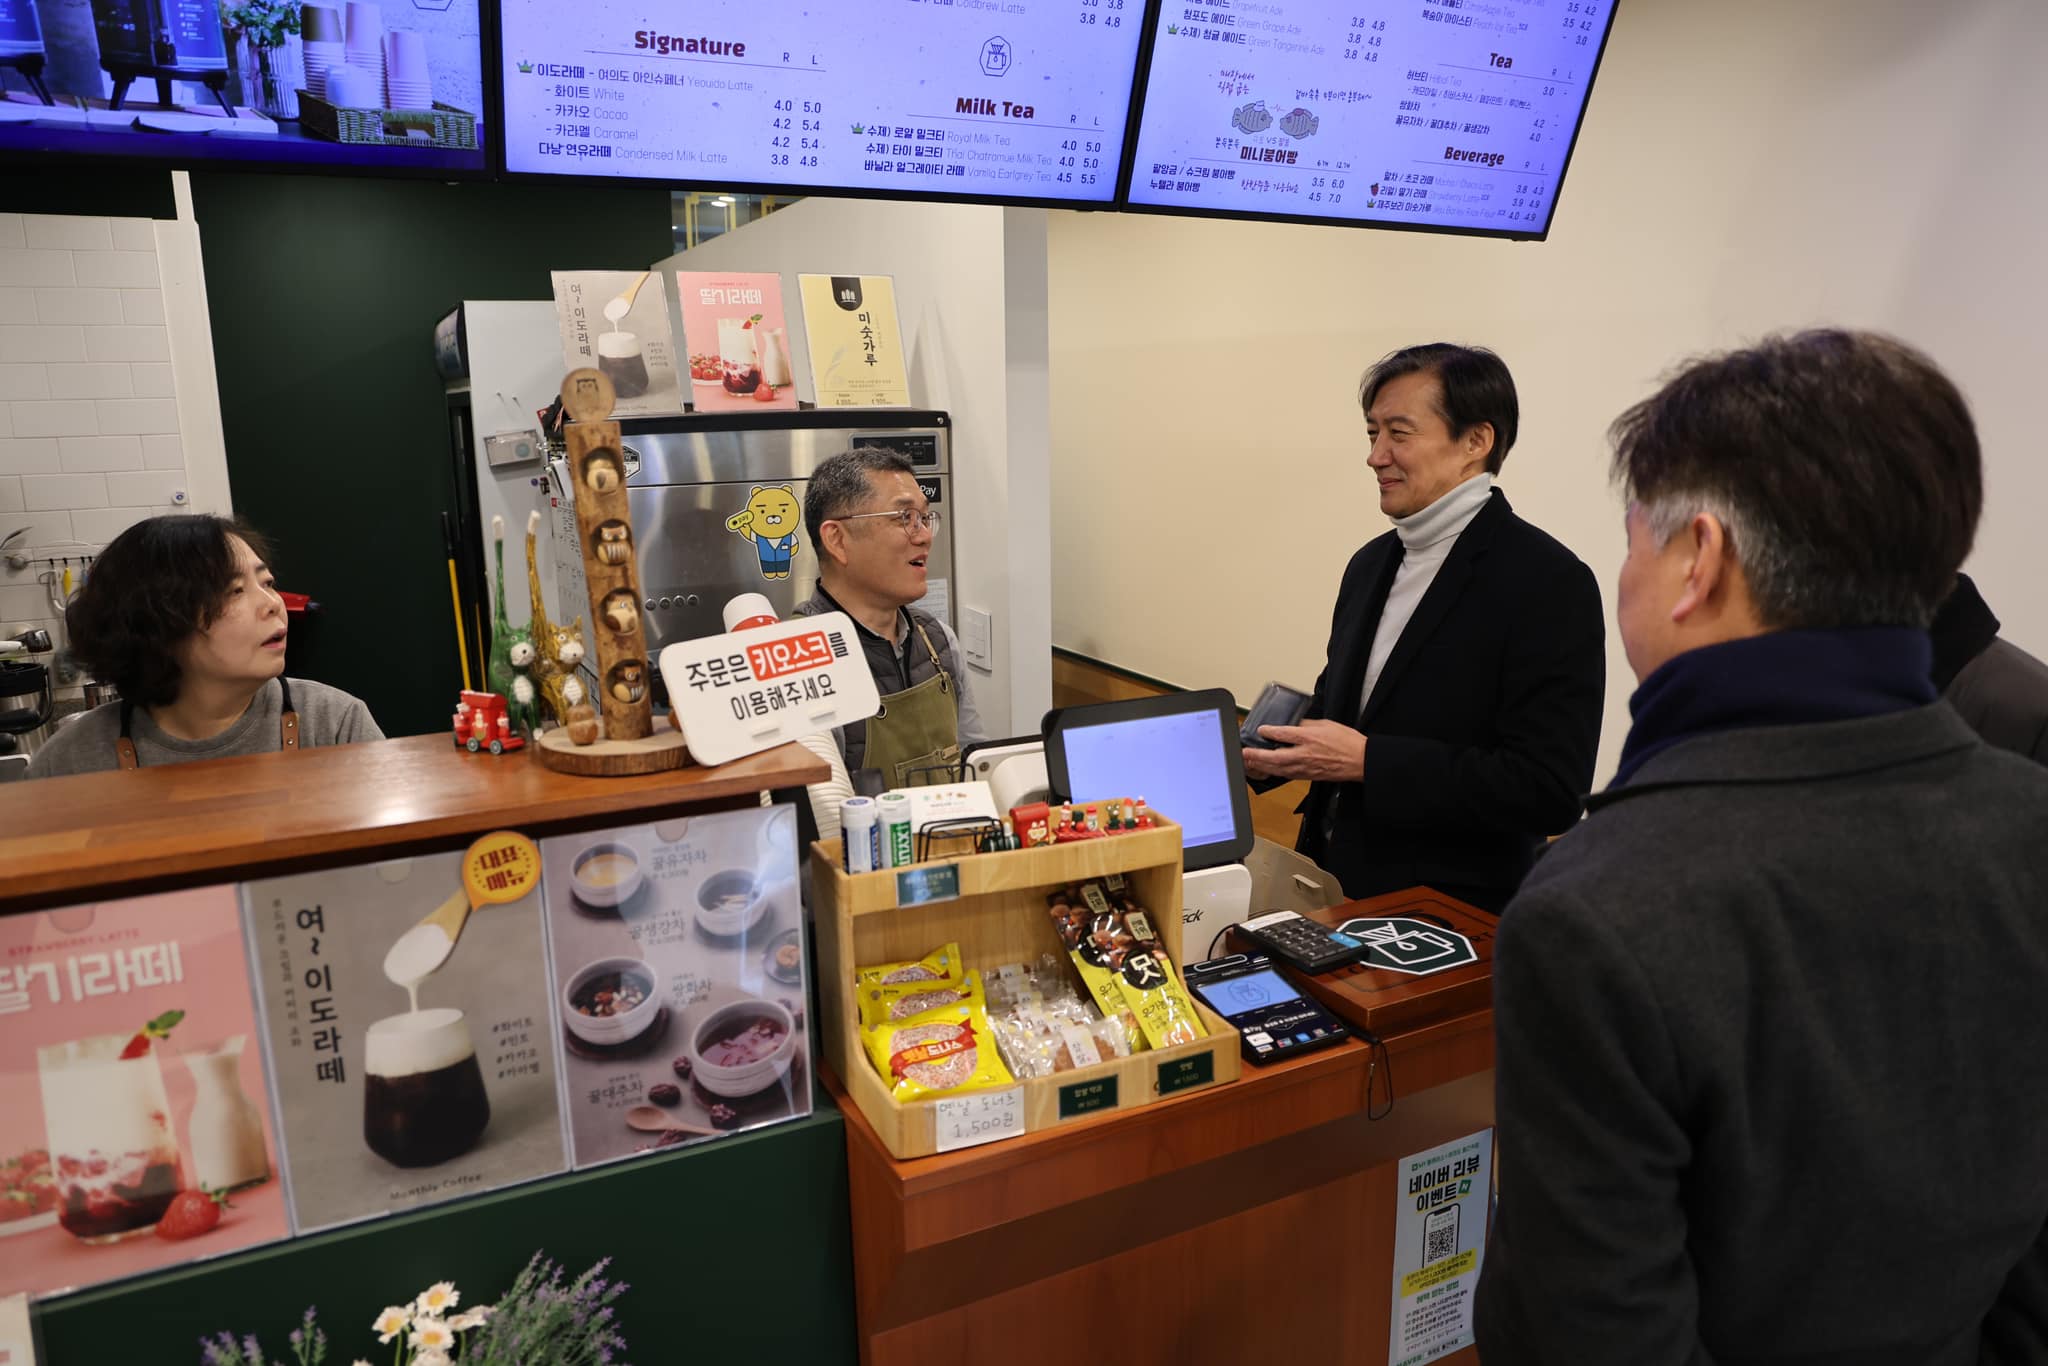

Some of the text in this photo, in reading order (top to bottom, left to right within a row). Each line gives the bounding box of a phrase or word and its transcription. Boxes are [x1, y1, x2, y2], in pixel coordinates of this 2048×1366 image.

[1001, 4, 1025, 15] Latte
[1567, 2, 1597, 16] 3.5 4.2
[1080, 13, 1120, 28] 3.8 4.8
[1211, 12, 1236, 26] 에이드
[1351, 17, 1386, 31] 3.8 4.8
[1562, 18, 1592, 31] 3.5 4.2
[1180, 26, 1201, 38] 수제)
[1221, 31, 1247, 45] 에이드
[1422, 9, 1444, 22] 복숭아
[1444, 12, 1473, 27] 아이스티
[1576, 35, 1588, 46] 3.0
[634, 30, 746, 57] Signature
[1347, 33, 1382, 47] 3.8 4.8
[783, 52, 818, 65] R L
[1344, 49, 1378, 63] 3.8 4.8
[1489, 52, 1513, 69] Tea
[537, 63, 753, 92] 이도라떼 여의도 아인슈페너 Yeouido Latte
[1406, 69, 1428, 82] 허브티
[1542, 86, 1555, 97] 3.0
[554, 84, 624, 101] 화이트 White
[554, 105, 629, 121] 카카오 Cacao
[774, 100, 821, 114] 4.0 5.0
[956, 97, 1035, 119] Milk Tea
[773, 118, 820, 132] 4.2 5.4
[1070, 115, 1099, 126] R L
[1533, 119, 1545, 129] 4.2
[554, 124, 638, 140] 카라멜 Caramel
[867, 126, 1010, 146] 수제) 로얄 밀크티 Royal Milk Tea
[1266, 136, 1277, 144] VS
[1529, 132, 1541, 143] 4.0
[772, 136, 819, 150] 4.2 5.4
[1062, 140, 1101, 153] 4.0 5.0
[539, 142, 728, 165] 다낭 연유라떼 Condensed Milk Latte
[771, 154, 818, 167] 3.8 4.8
[866, 143, 889, 155] 수제)
[892, 144, 912, 157] 타이
[914, 146, 943, 158] 밀크티
[946, 147, 965, 159] Thai
[1016, 153, 1034, 165] Milk
[1036, 154, 1052, 166] Tea
[1240, 146, 1299, 164] 미니붕어빵
[1444, 146, 1505, 167] Beverage
[1059, 156, 1098, 169] 4.0 5.0
[864, 160, 894, 172] 바닐라
[896, 161, 943, 176] 얼그레이티
[946, 165, 965, 176] 라떼
[1034, 170, 1051, 183] Tea
[1057, 172, 1096, 184] 4.5 5.5
[1152, 163, 1236, 180] 팥앙금 슈크림 붕어빵
[1404, 173, 1419, 184] 초코
[1419, 174, 1434, 185] 라떼
[1150, 179, 1201, 192] 누텔라 붕어빵
[1311, 177, 1345, 189] 3.5 6.0
[1308, 191, 1341, 204] 4.5 7.0
[1399, 187, 1412, 198] 딸기
[1413, 188, 1428, 199] 라떼
[1404, 202, 1432, 213] 미숫가루
[700, 288, 762, 305] 딸기라떼
[858, 311, 878, 367] 미숫가루
[686, 631, 849, 692] 주문은 키오스크를
[730, 673, 837, 721] 이용해주세요
[480, 845, 521, 870] 대표
[485, 869, 525, 892] 메뉴
[296, 904, 346, 1083] 여~이도라떼
[954, 1112, 1014, 1138] 1,500원
[1409, 1165, 1450, 1194] 네이버
[1453, 1154, 1480, 1178] 리뷰
[1416, 1182, 1457, 1212] 이벤트
